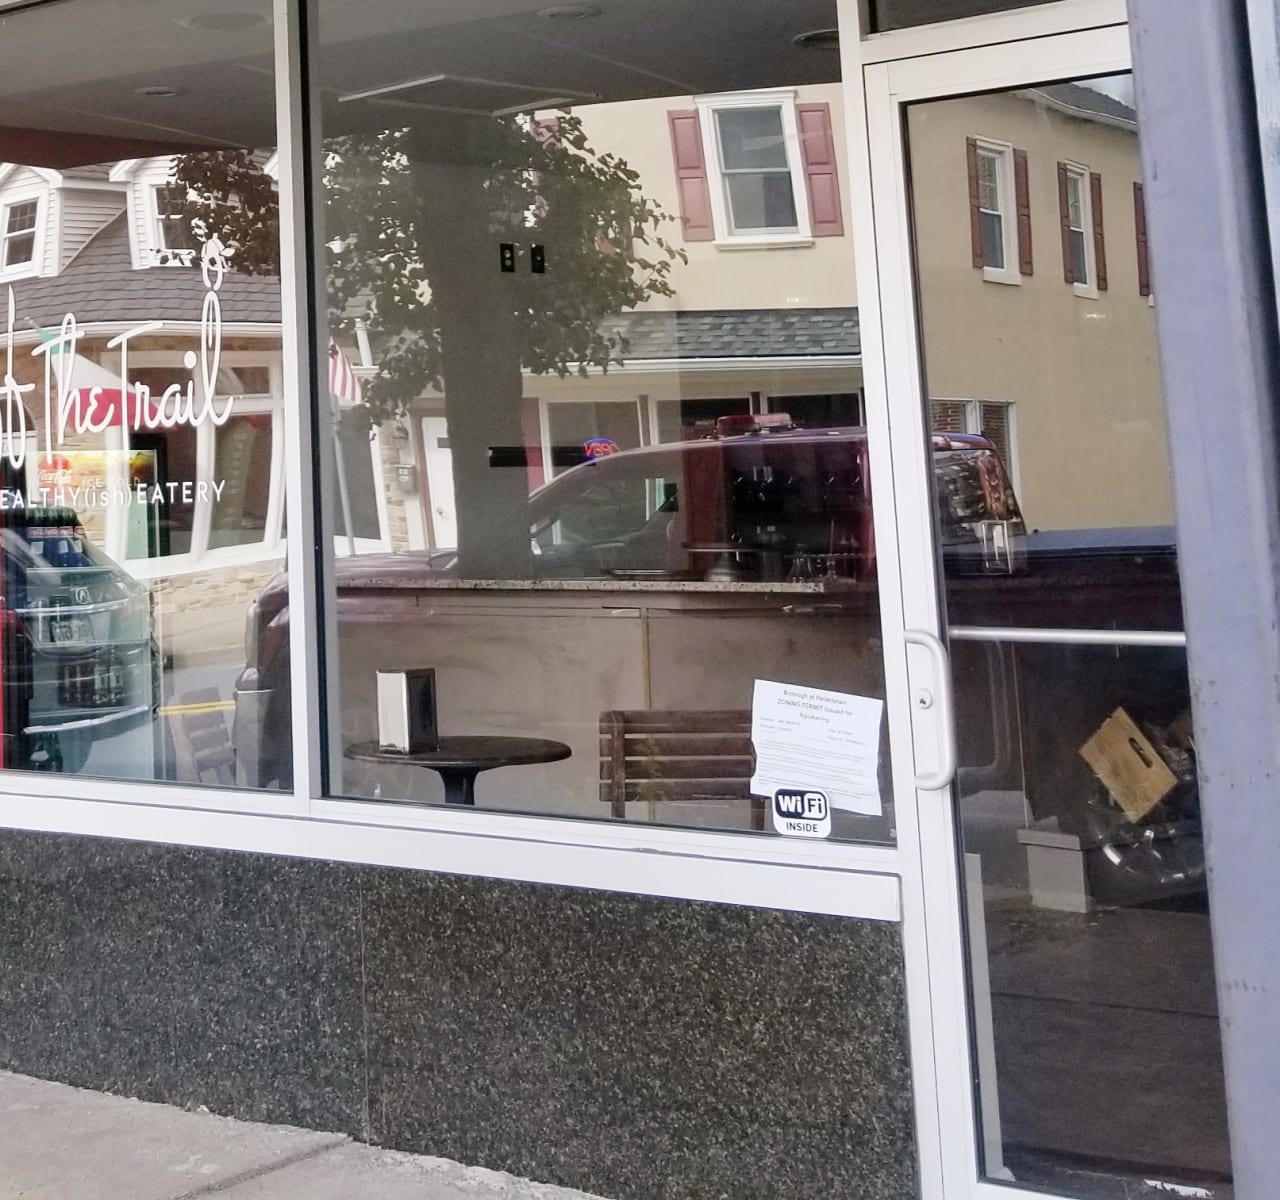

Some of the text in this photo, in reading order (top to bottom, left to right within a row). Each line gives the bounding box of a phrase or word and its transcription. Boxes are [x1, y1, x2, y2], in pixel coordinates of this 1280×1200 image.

[31, 312, 114, 465] The
[107, 290, 233, 450] Trail
[786, 822, 819, 833] INSIDE
